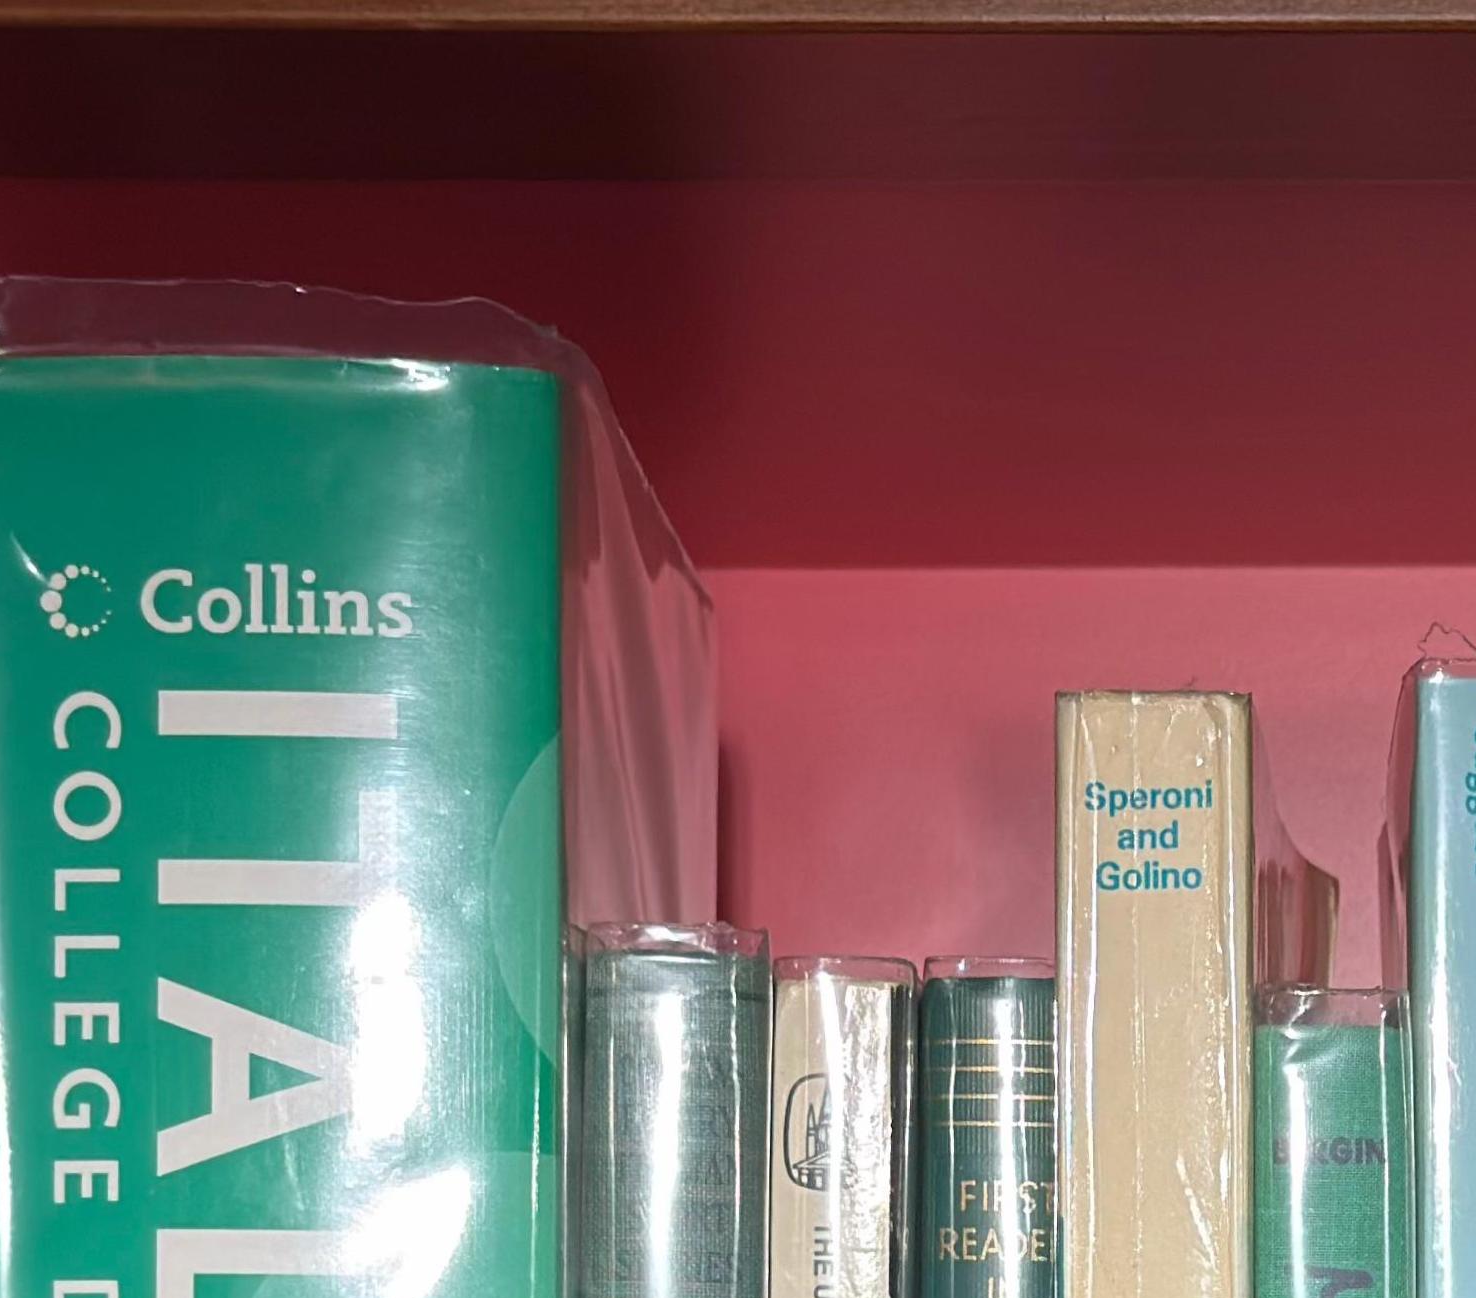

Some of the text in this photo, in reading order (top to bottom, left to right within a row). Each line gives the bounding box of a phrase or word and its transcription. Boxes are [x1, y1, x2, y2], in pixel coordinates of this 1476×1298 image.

[141, 563, 413, 639] Collins
[1084, 779, 1214, 813] Speroni
[1117, 820, 1180, 850] and
[1096, 861, 1203, 891] Golino
[52, 690, 122, 1203] COLLEGE
[1275, 1137, 1386, 1165] BRGIN
[813, 1226, 835, 1277] THE
